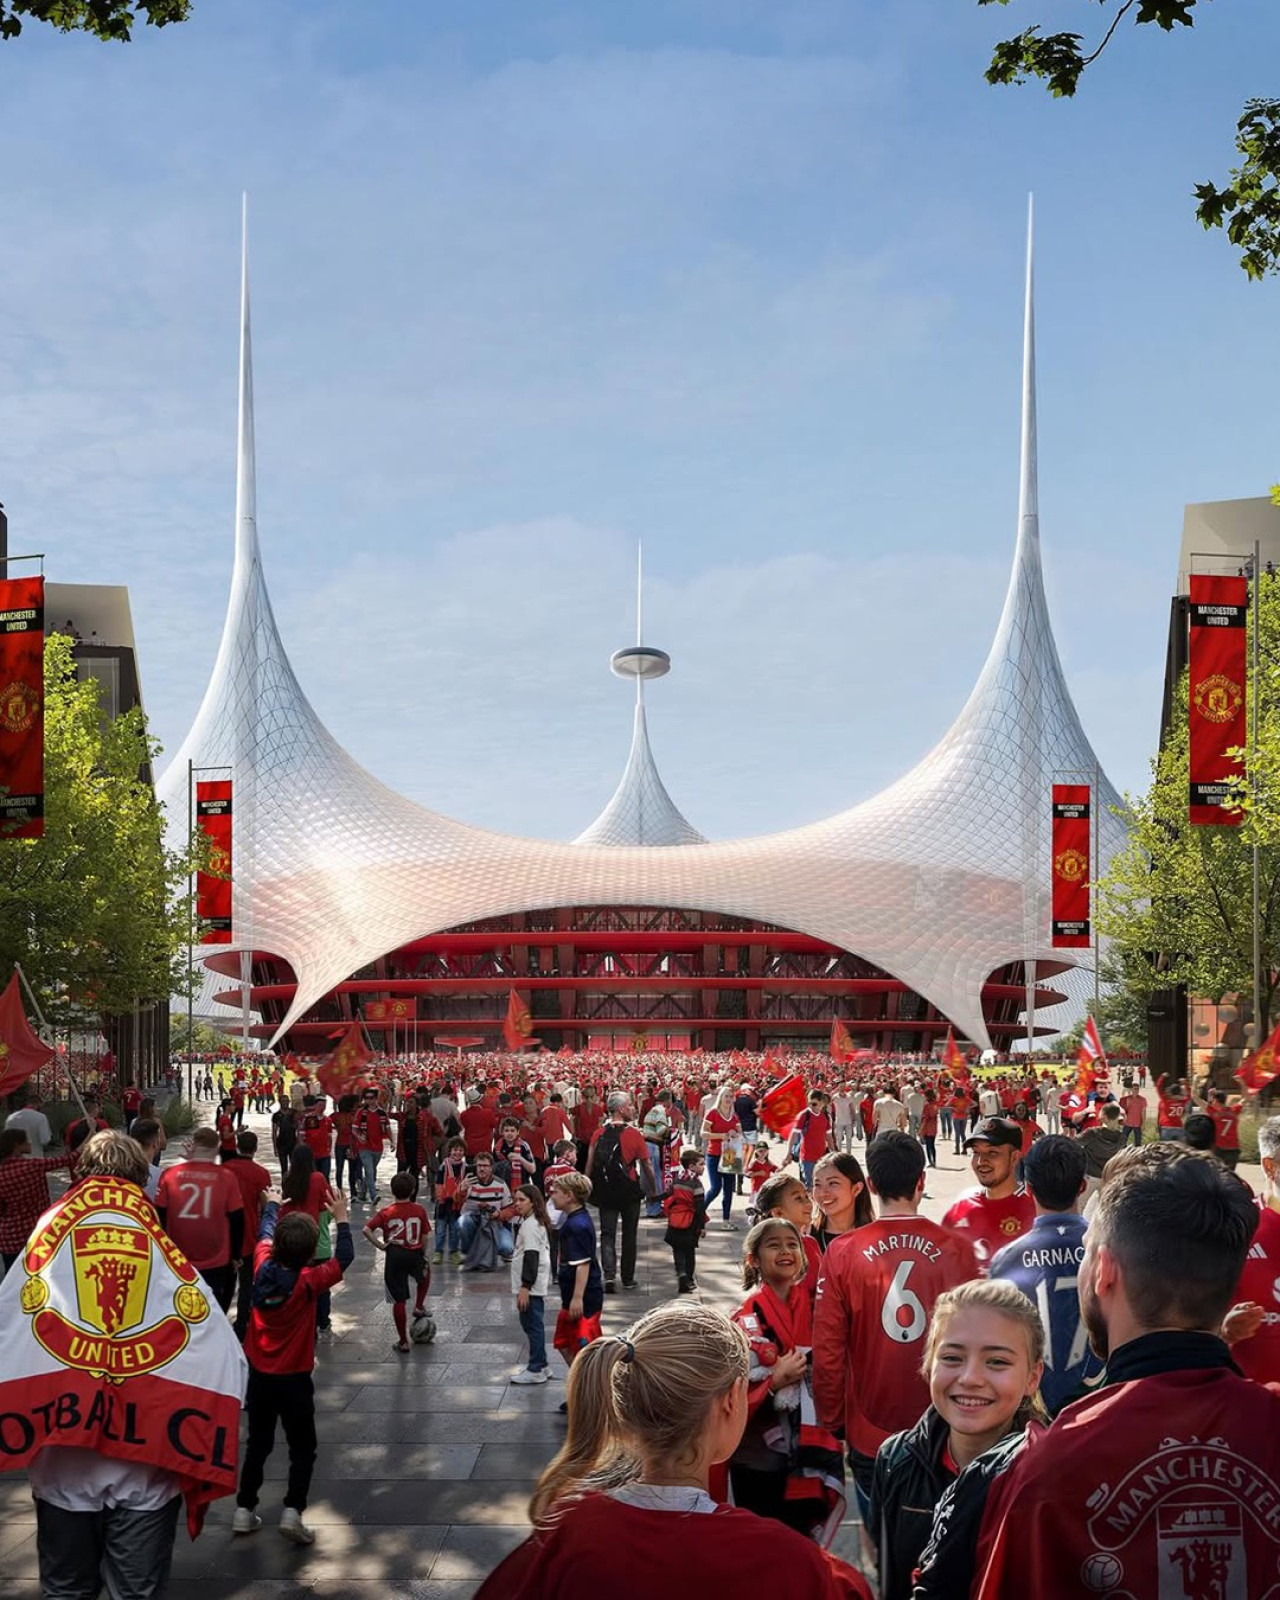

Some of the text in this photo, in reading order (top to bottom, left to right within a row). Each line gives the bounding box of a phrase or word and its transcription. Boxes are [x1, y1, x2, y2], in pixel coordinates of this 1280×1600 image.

[1198, 605, 1238, 616] MANCHESTER
[1206, 616, 1229, 626] UNITED
[6, 621, 28, 632] UNITED
[1168, 1106, 1184, 1117] 20
[1221, 1119, 1233, 1137] 7
[178, 1183, 212, 1219] 21
[387, 1216, 422, 1246] 20
[862, 1233, 943, 1264] MARTINEZ
[881, 1260, 927, 1343] 6
[1035, 1276, 1090, 1372] 17
[68, 1336, 155, 1369] UNITED
[1105, 1455, 1280, 1532] MANCHESTER
